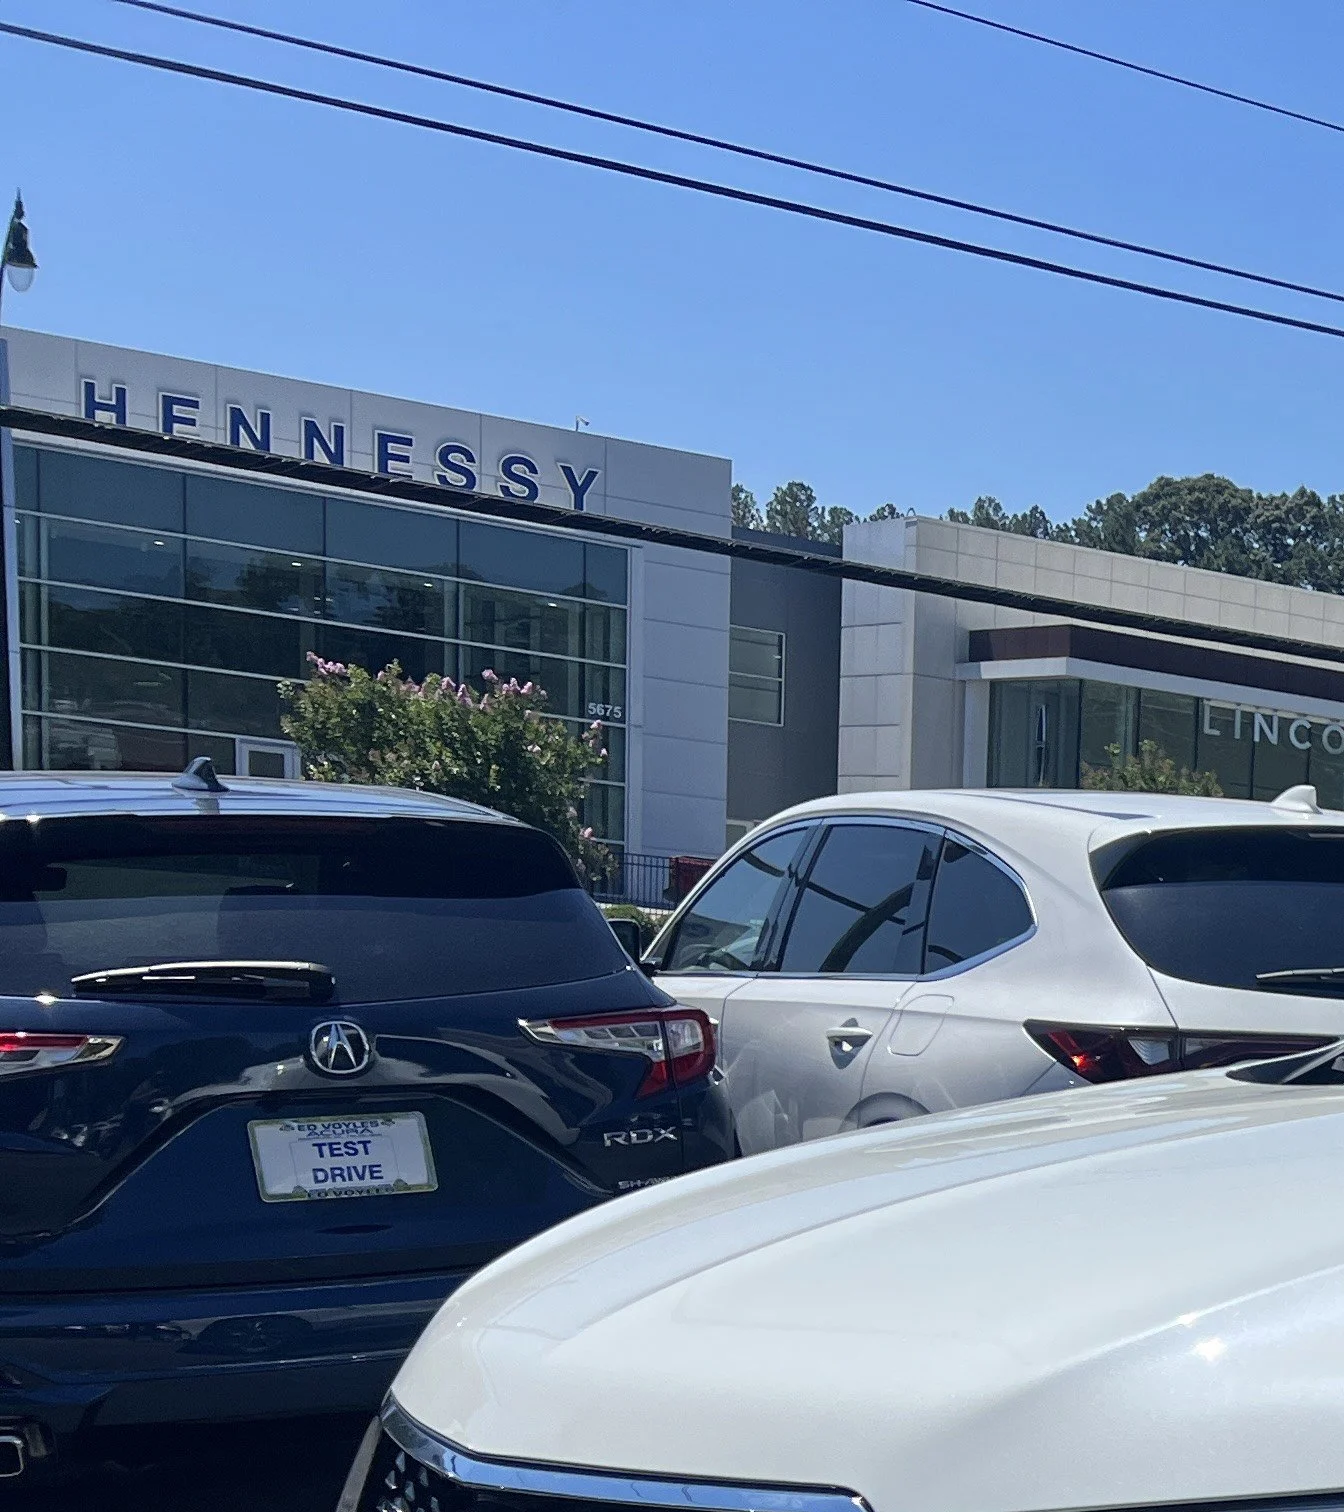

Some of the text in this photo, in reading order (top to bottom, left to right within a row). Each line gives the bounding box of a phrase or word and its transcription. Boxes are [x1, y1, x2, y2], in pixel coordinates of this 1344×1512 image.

[80, 378, 601, 512] HENNESSY
[587, 702, 622, 719] 5675
[297, 1120, 380, 1132] ED VOYLES
[306, 1128, 374, 1137] ACURA
[603, 1126, 678, 1147] RDX
[312, 1140, 373, 1159] TEST
[312, 1164, 384, 1185] DRIVE
